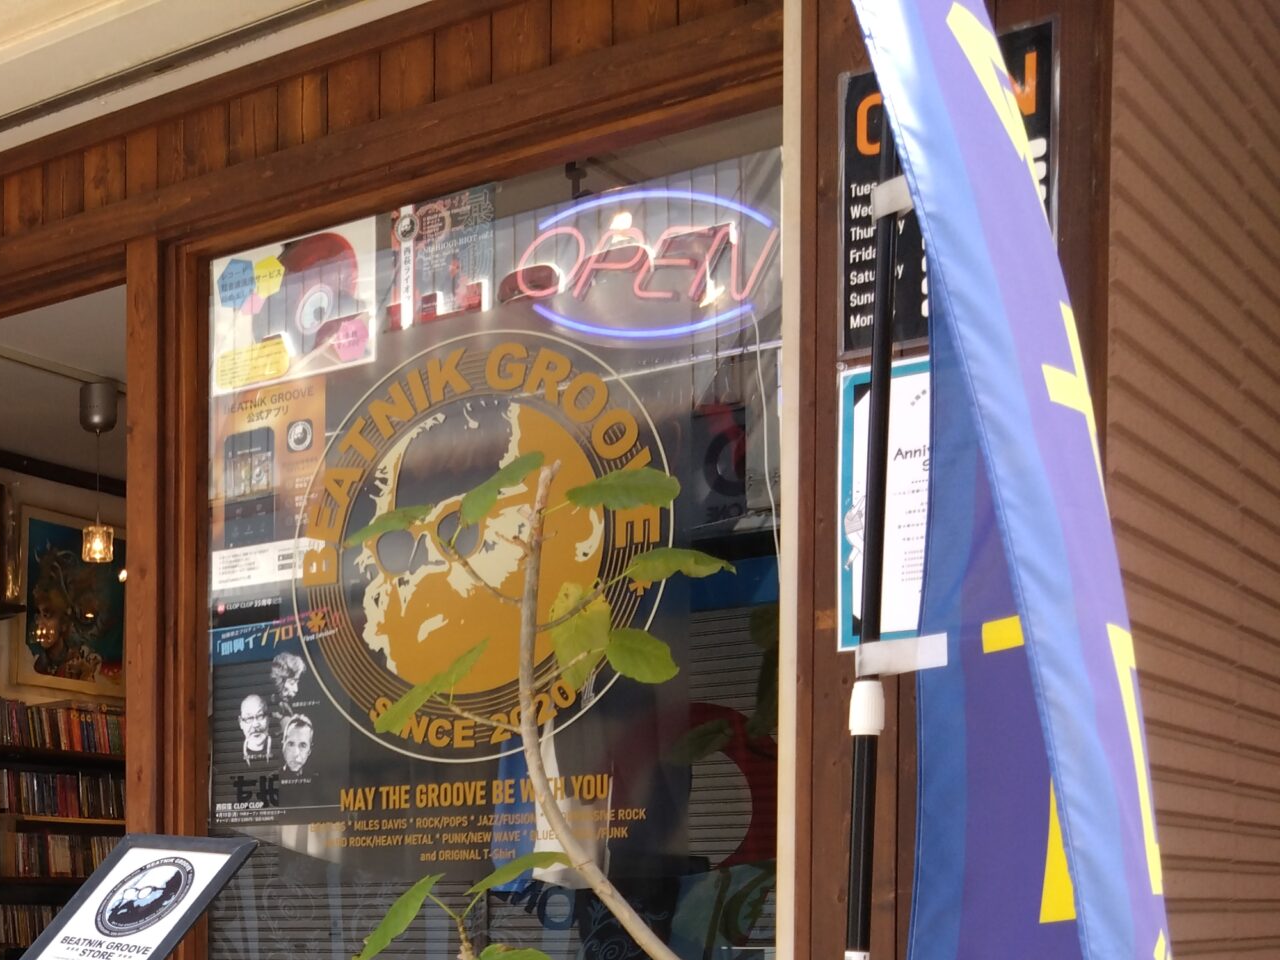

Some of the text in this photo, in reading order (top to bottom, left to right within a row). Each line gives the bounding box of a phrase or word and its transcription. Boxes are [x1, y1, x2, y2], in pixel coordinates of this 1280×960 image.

[516, 221, 777, 300] OPEN
[270, 385, 314, 405] GROOVE
[302, 346, 472, 587] BEATNIK
[484, 342, 661, 546] GROOVE
[369, 696, 478, 749] SNCE
[340, 786, 377, 811] MAY
[381, 784, 410, 809] THE
[416, 781, 486, 807] GROOVE
[492, 779, 515, 805] BE
[573, 774, 609, 800] YOU
[353, 818, 380, 832] MILES
[381, 817, 408, 831] DAVIS
[415, 814, 468, 830] ROCK/POPS
[617, 808, 646, 821] ROCK
[349, 834, 403, 849] ROCK/HEAVY
[404, 833, 434, 846] METAL
[442, 830, 491, 846] PUNK/NEW
[494, 829, 520, 843] WAVE
[420, 847, 516, 862] and ORIGINAL T-Shirt
[60, 935, 152, 956] BEATNIK GROOVE
[78, 947, 114, 960] STORE
